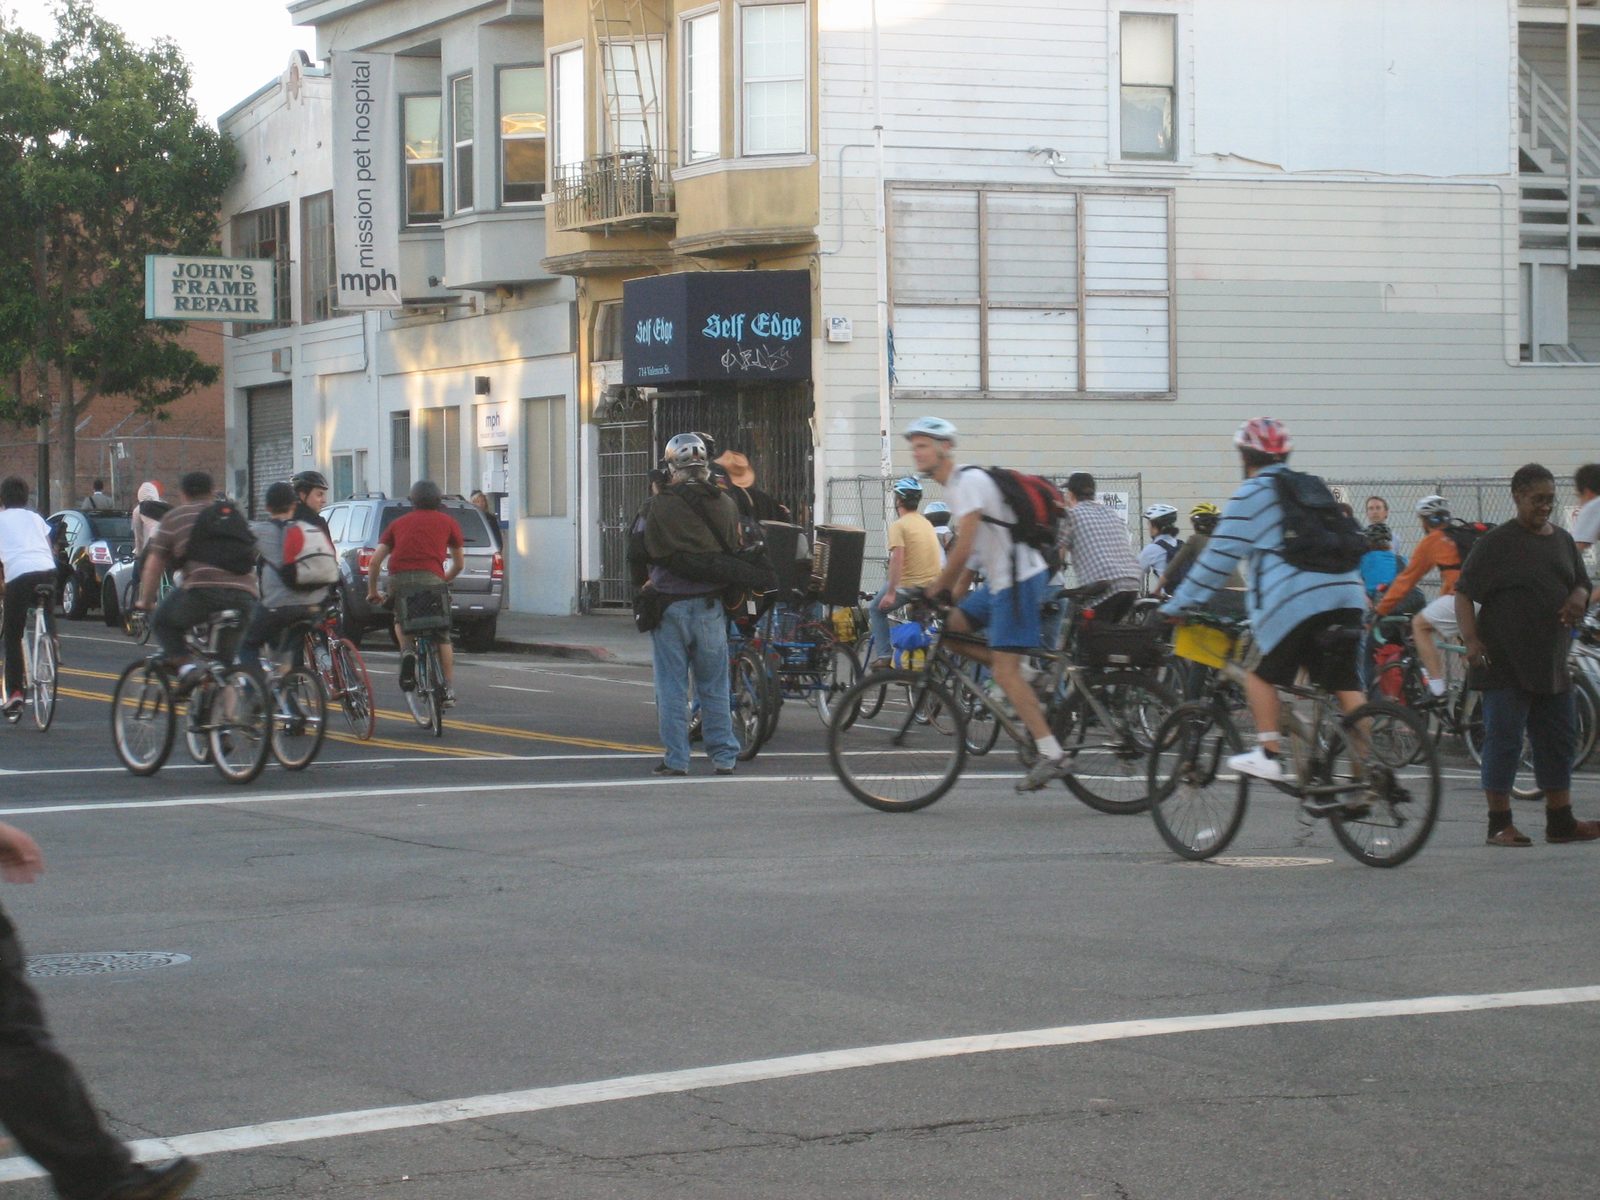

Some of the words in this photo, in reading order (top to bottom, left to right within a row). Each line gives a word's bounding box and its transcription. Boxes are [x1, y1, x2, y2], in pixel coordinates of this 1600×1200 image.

[351, 60, 375, 142] hospital
[353, 148, 376, 181] pet
[354, 189, 374, 268] mission
[172, 263, 254, 280] JOHN'S
[340, 268, 397, 297] mph
[171, 279, 257, 296] FRAME
[174, 296, 259, 313] REPAIR
[635, 318, 652, 347] Self
[653, 316, 673, 345] Edge
[701, 312, 746, 342] Self
[750, 311, 802, 341] Edge
[485, 413, 501, 430] mph
